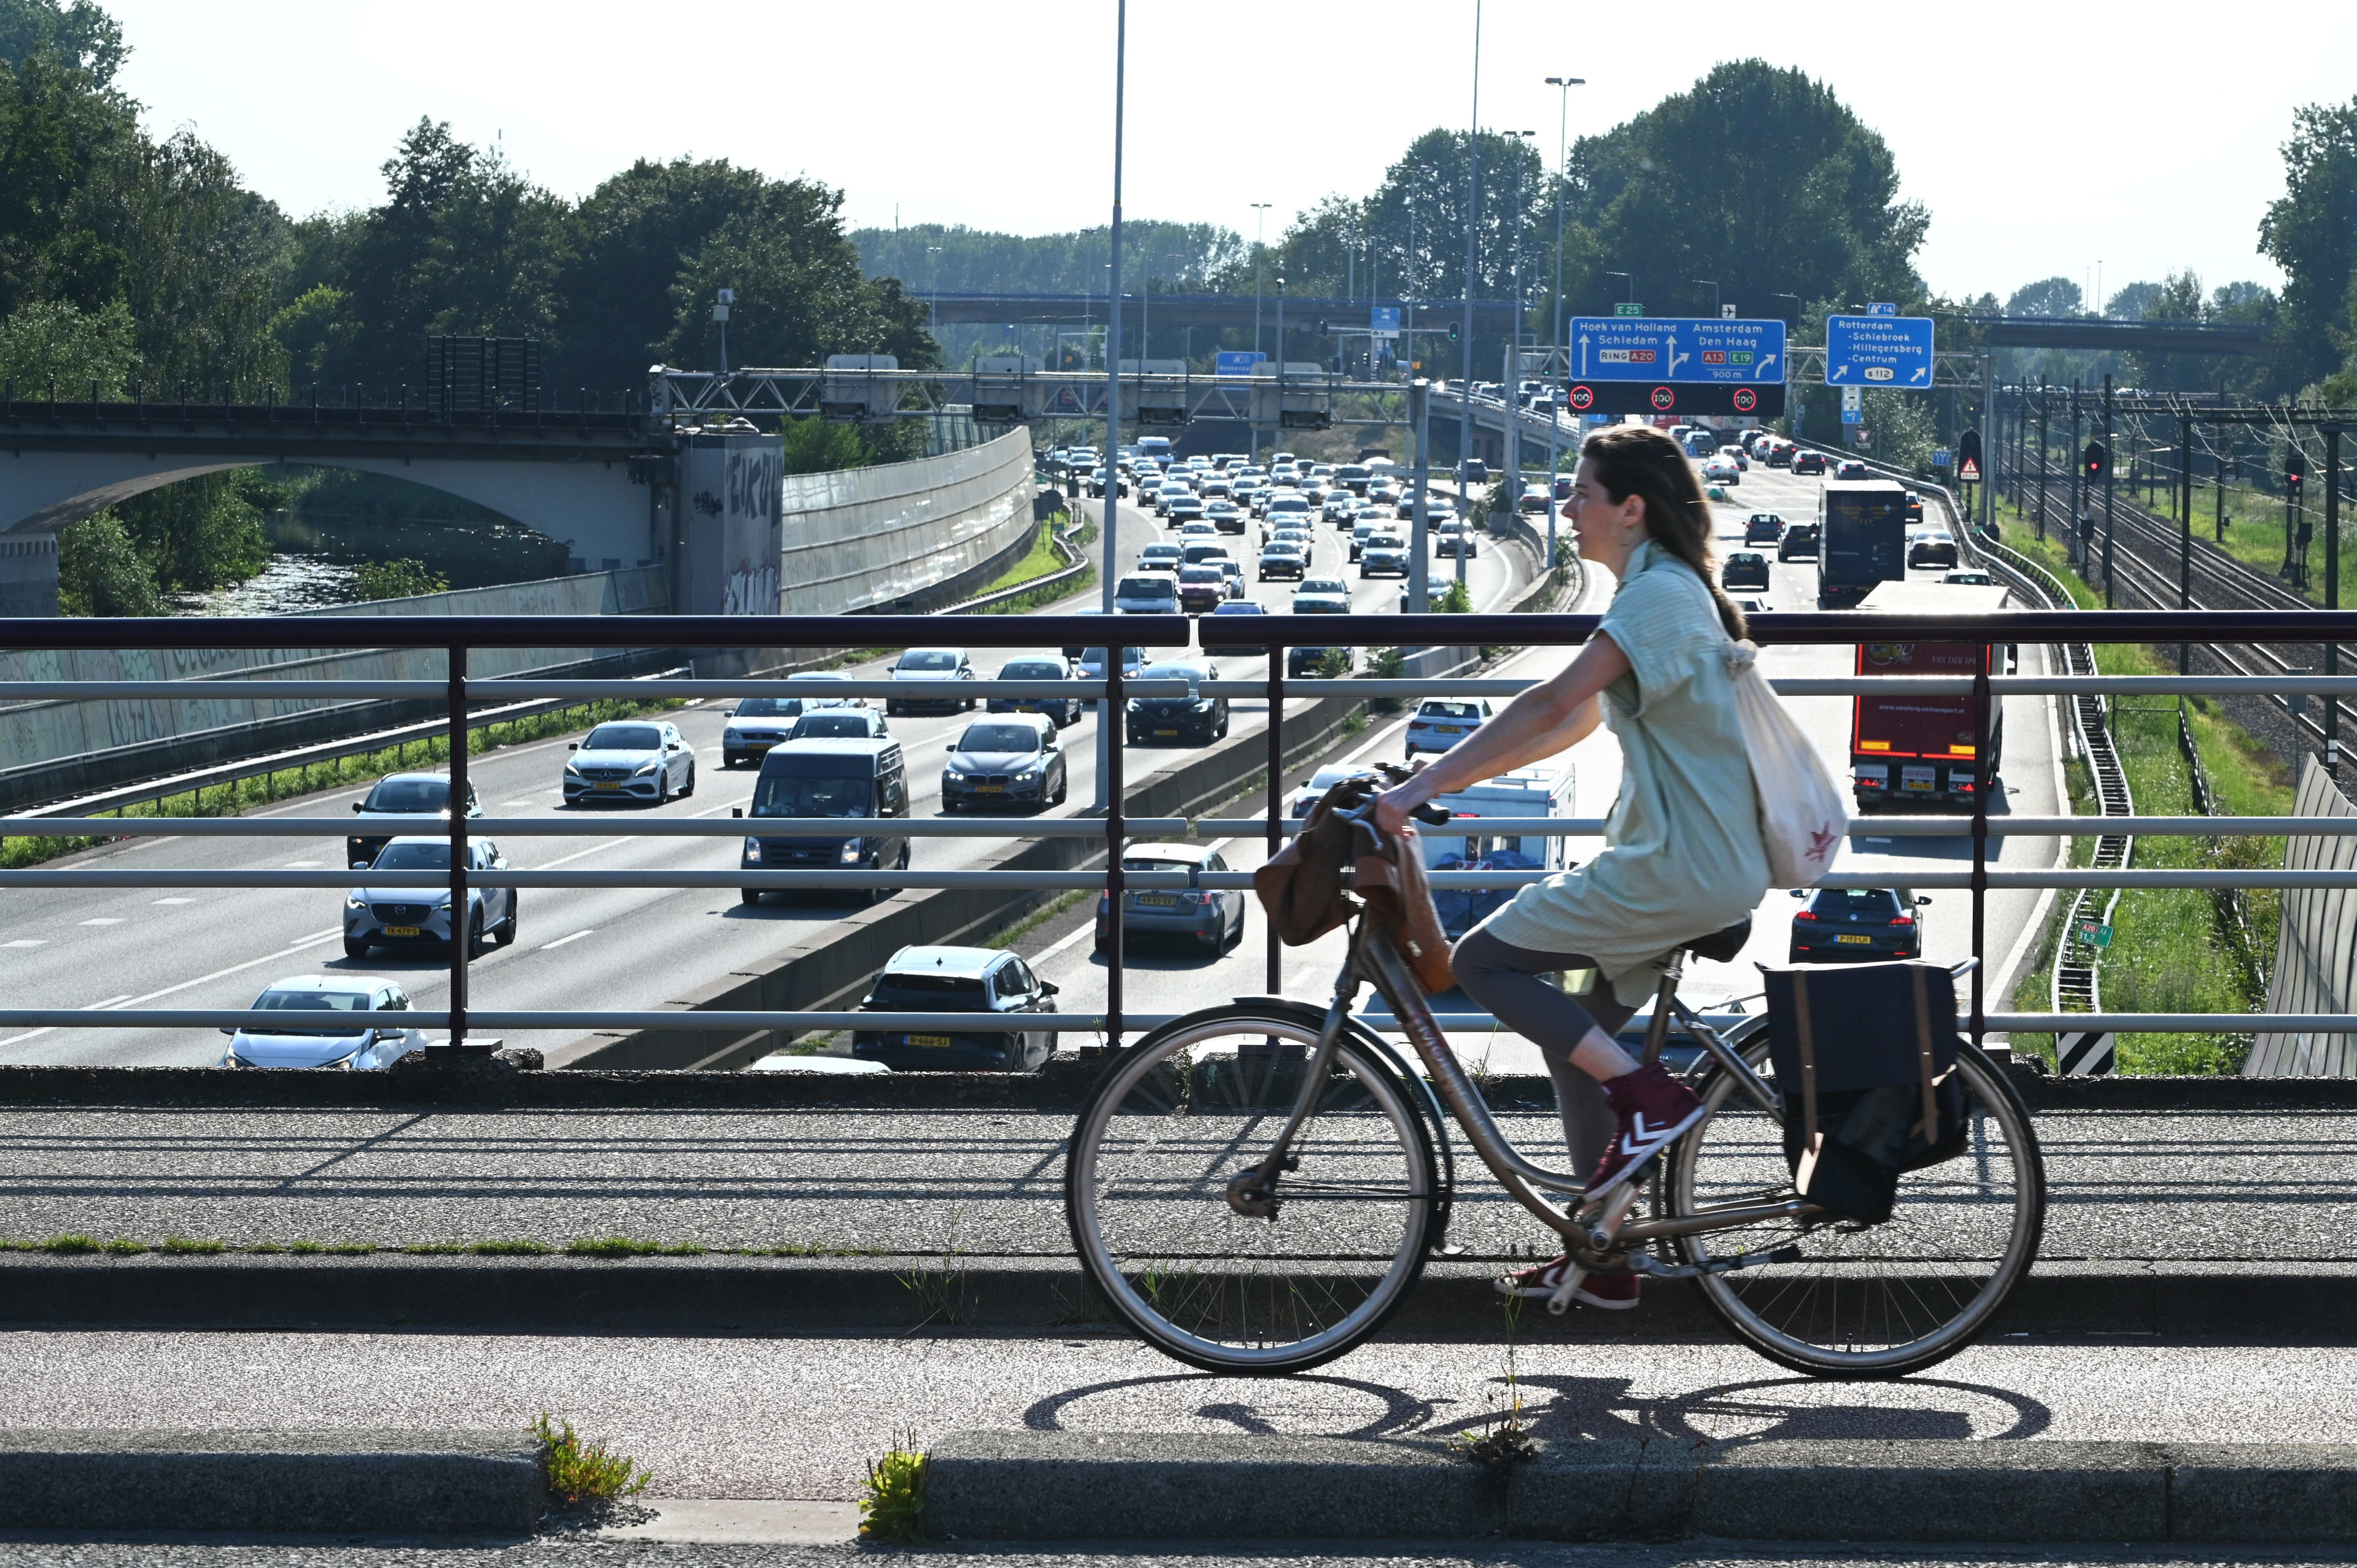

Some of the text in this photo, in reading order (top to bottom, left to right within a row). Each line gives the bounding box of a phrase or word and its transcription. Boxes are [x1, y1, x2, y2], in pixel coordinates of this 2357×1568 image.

[1580, 322, 1608, 331] Hoek
[1635, 323, 1676, 333] Holland
[1693, 323, 1762, 334] Amsterdam
[1838, 320, 1893, 330] Rotterdam
[1598, 336, 1658, 345] Schiedam
[1699, 337, 1757, 349] Den Haag
[1601, 352, 1652, 361] RING A20
[1705, 353, 1724, 362] A13
[1573, 393, 1590, 402] 100
[1654, 394, 1671, 403] 100
[1736, 395, 1753, 404] 100
[1932, 655, 1946, 664] VAN
[1948, 656, 1963, 665] DER
[2082, 924, 2096, 932] A20
[910, 1036, 947, 1046] N-666-SJ
